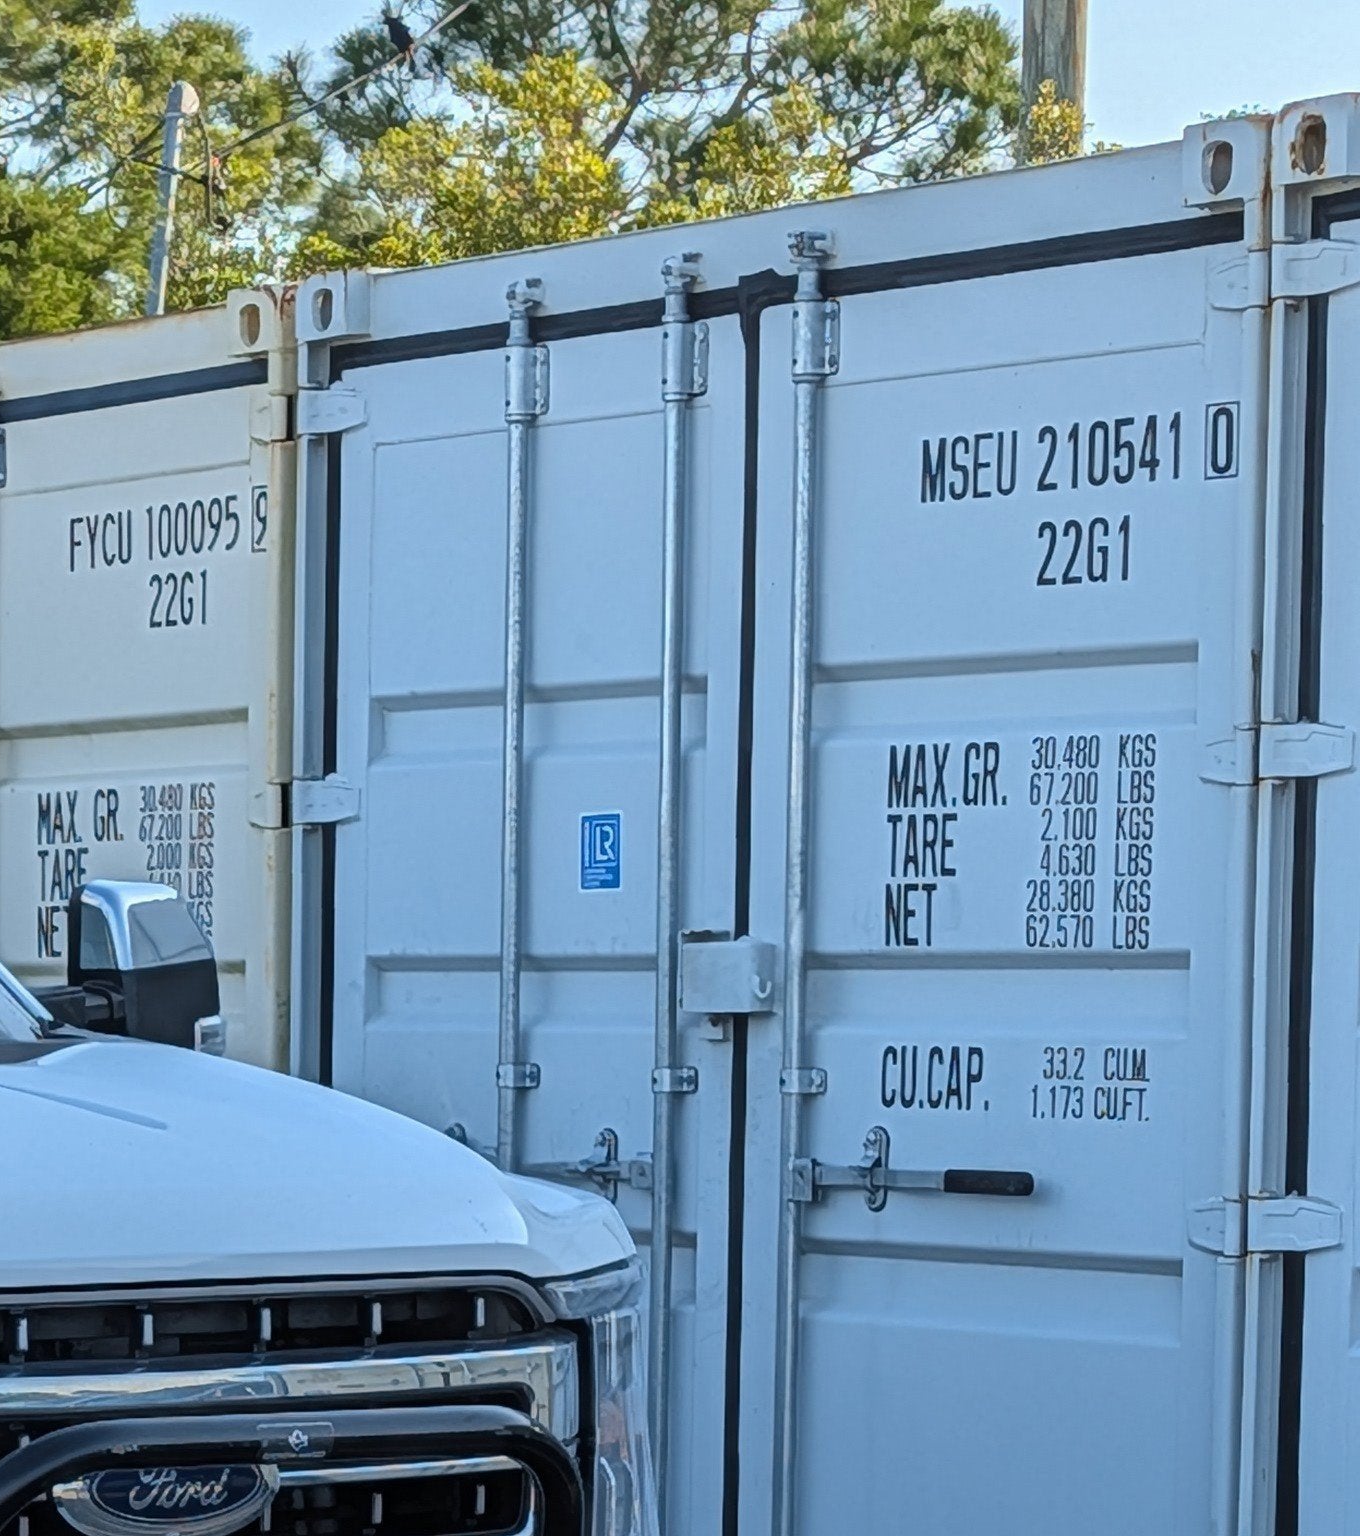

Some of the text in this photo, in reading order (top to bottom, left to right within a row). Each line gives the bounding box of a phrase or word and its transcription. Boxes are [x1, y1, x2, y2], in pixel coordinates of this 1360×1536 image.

[920, 406, 1235, 503] MSEU 210541 0
[69, 490, 268, 573] FYCU 100095 9
[1036, 514, 1130, 586] 22G1
[149, 569, 208, 629] 22G1
[1118, 733, 1157, 768] KGS
[93, 788, 124, 842] GR.
[189, 782, 216, 811] KGS
[1030, 770, 1155, 806] 67.200 LBS
[189, 811, 215, 841] LBS
[887, 813, 958, 877] TARE
[1115, 806, 1154, 841] KGS
[188, 842, 215, 870] KGS
[1040, 843, 1153, 877] 4.630 LBS
[187, 871, 214, 899] LBS
[885, 879, 1151, 947] NET 28.380 KGS
[1112, 915, 1150, 950] LBS
[881, 1045, 989, 1112] CU.CAP.
[1043, 1046, 1085, 1081] 33.2
[129, 1468, 228, 1510] Ford
